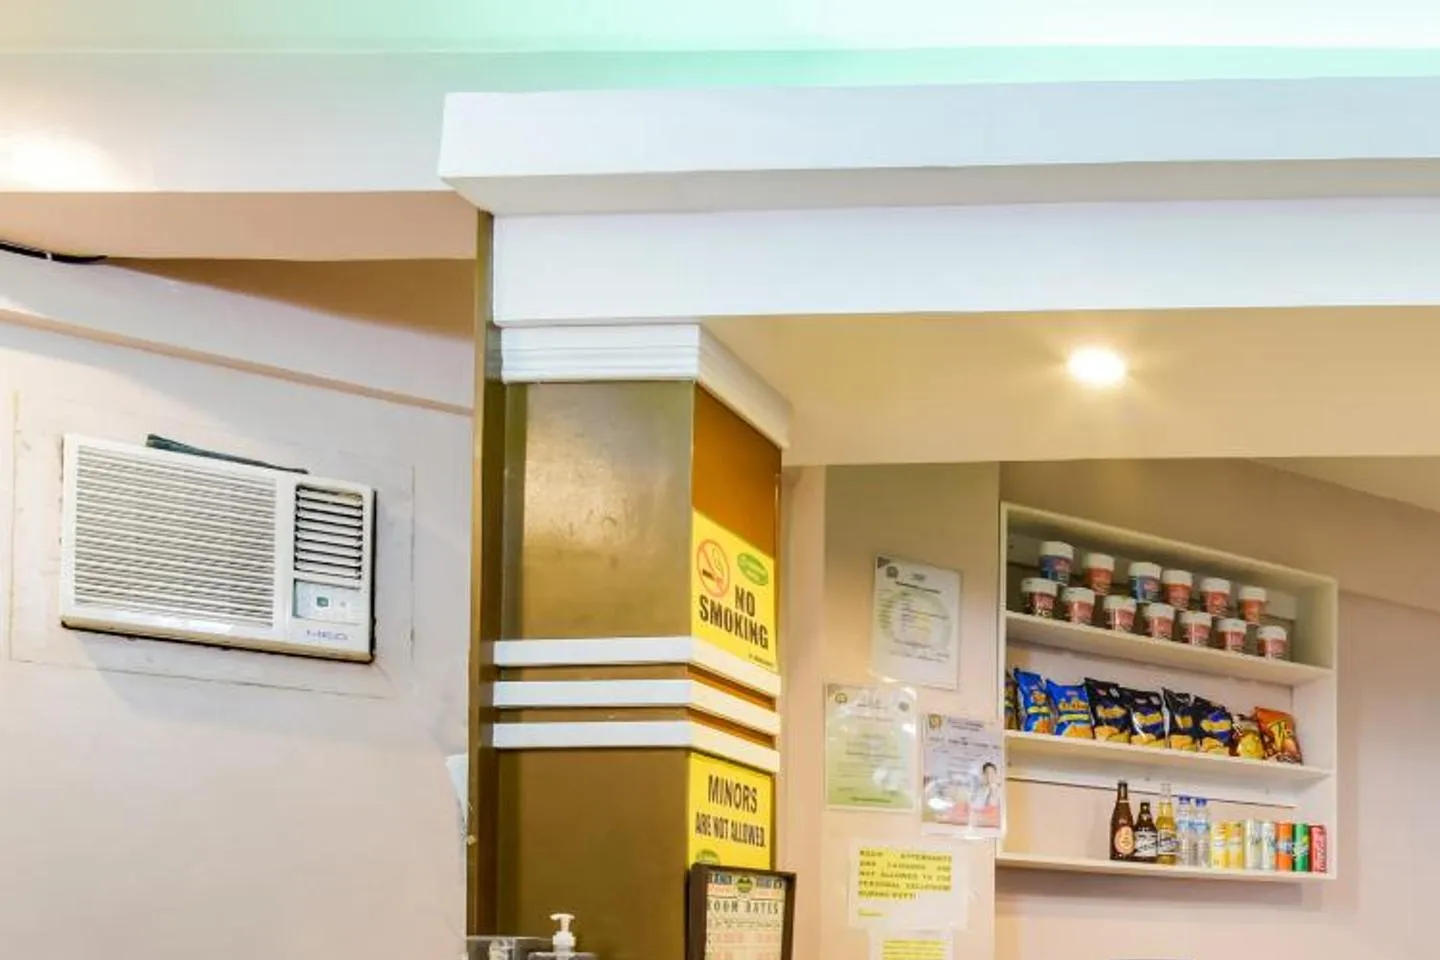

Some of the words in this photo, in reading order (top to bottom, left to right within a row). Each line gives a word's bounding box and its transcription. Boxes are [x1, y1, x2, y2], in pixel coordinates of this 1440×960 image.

[735, 585, 755, 617] NO
[699, 594, 769, 650] SMOKING
[708, 774, 757, 814] MINORS
[695, 811, 711, 836] ARE
[713, 816, 728, 840] NOT
